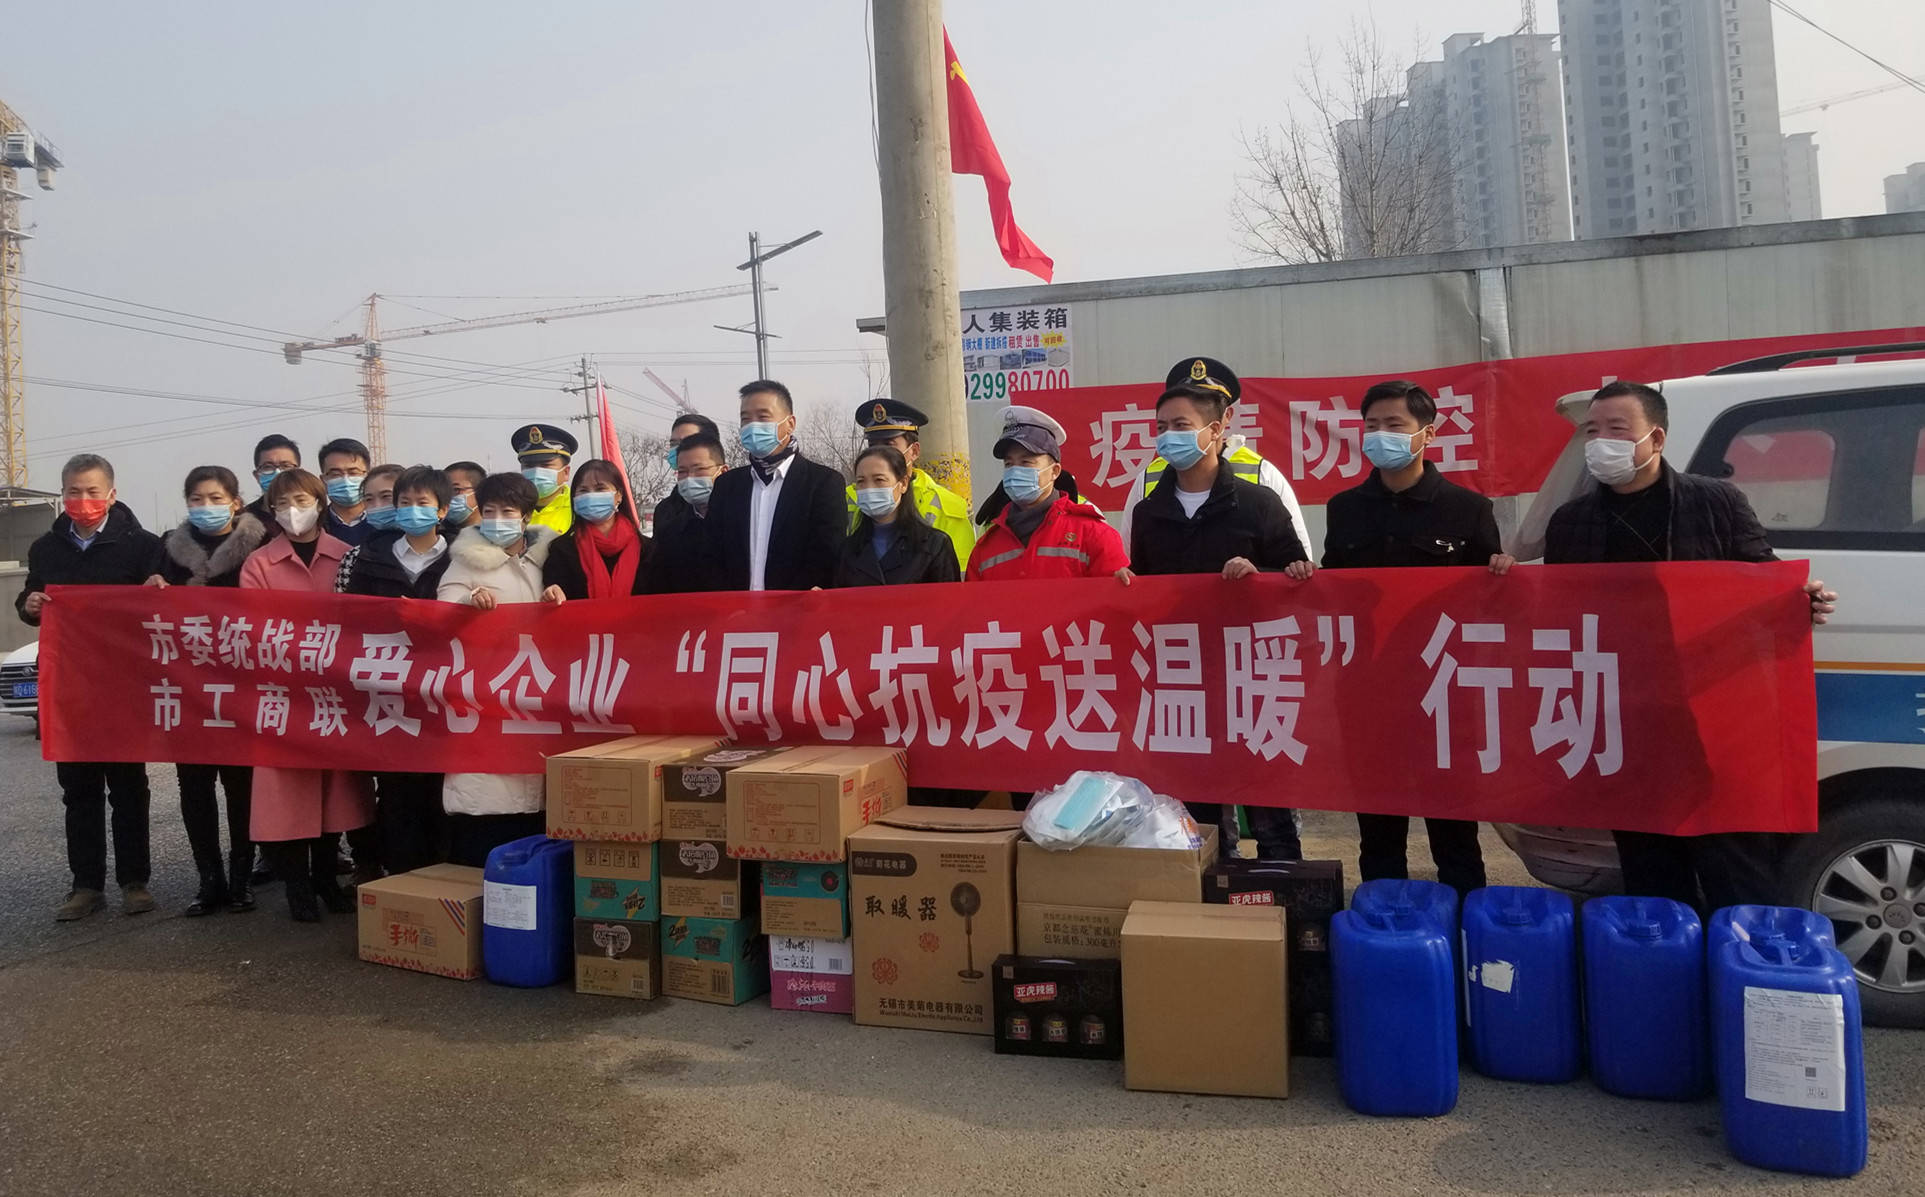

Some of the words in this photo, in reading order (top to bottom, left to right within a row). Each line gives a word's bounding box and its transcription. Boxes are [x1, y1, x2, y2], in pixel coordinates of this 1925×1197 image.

[962, 308, 1068, 334] 人集装箱
[964, 368, 1070, 400] 29980700
[141, 613, 342, 676] 市委统战部
[149, 677, 349, 738] 市工商联
[1419, 611, 1625, 780] 行动
[864, 894, 938, 921] 取暖器
